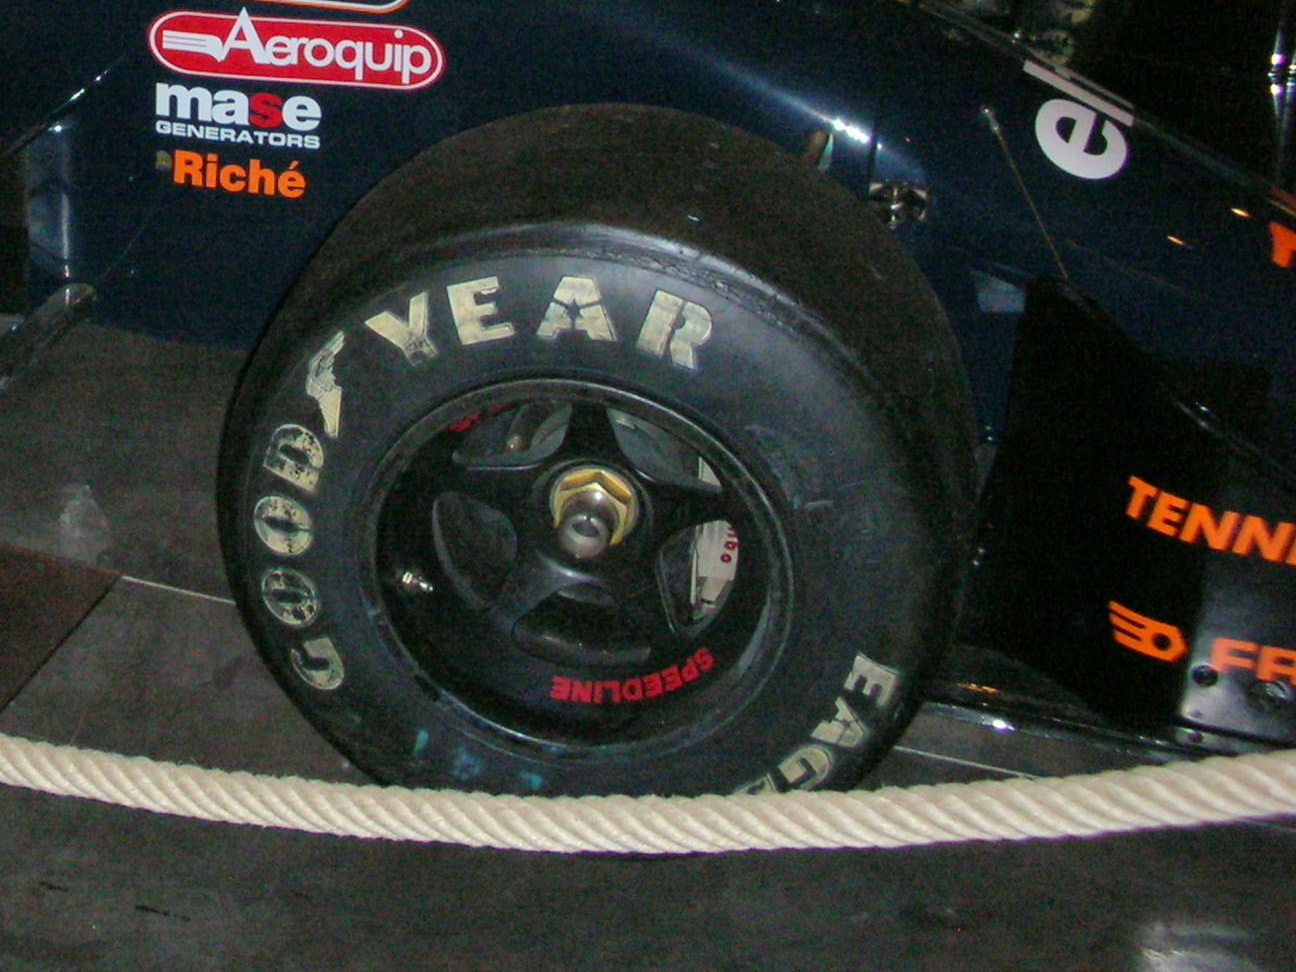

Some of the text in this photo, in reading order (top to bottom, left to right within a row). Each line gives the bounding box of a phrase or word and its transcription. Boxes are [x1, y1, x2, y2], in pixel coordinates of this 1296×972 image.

[217, 6, 433, 85] Aeroquip
[155, 82, 322, 132] mase
[155, 118, 321, 150] GENERATORS
[172, 149, 307, 200] Riché
[252, 274, 714, 692] GOOD YEAR
[548, 645, 716, 707] SPEEDLINE
